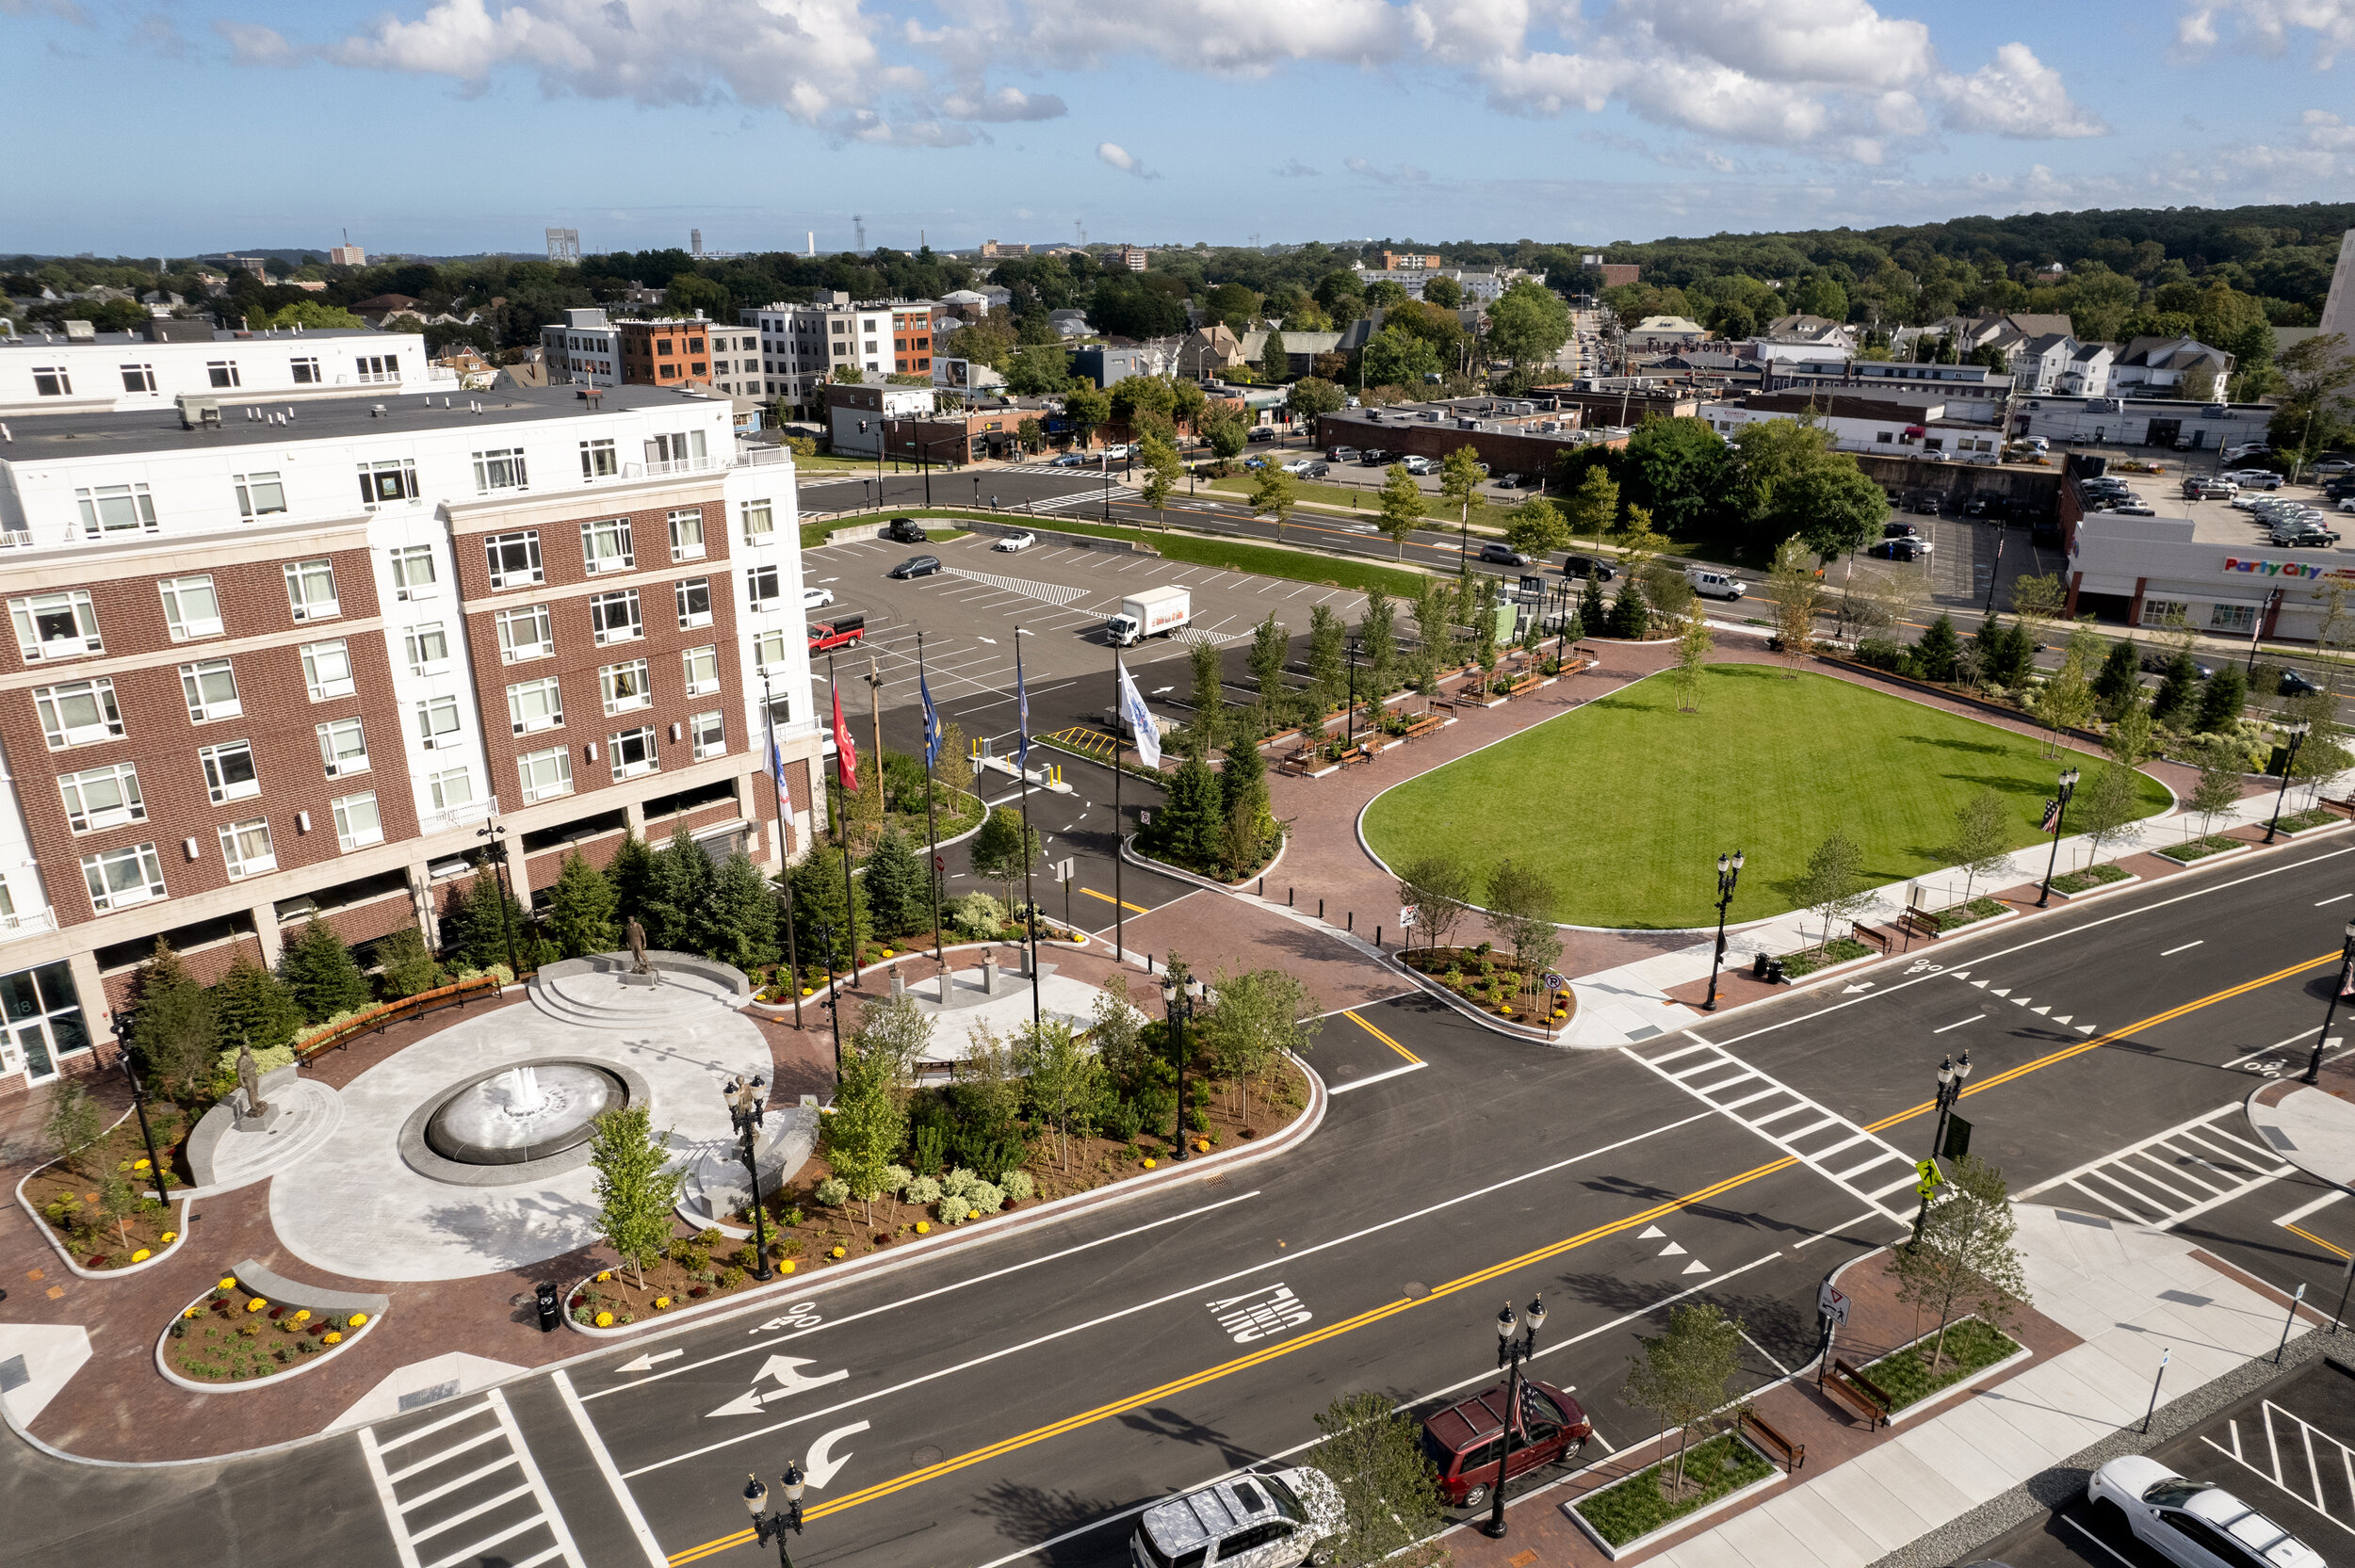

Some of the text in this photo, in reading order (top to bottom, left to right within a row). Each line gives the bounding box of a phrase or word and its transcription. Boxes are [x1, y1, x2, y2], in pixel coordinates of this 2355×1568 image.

[2225, 558, 2323, 579] Party City
[13, 1000, 32, 1014] 18
[1206, 1282, 1313, 1344] ONLY
